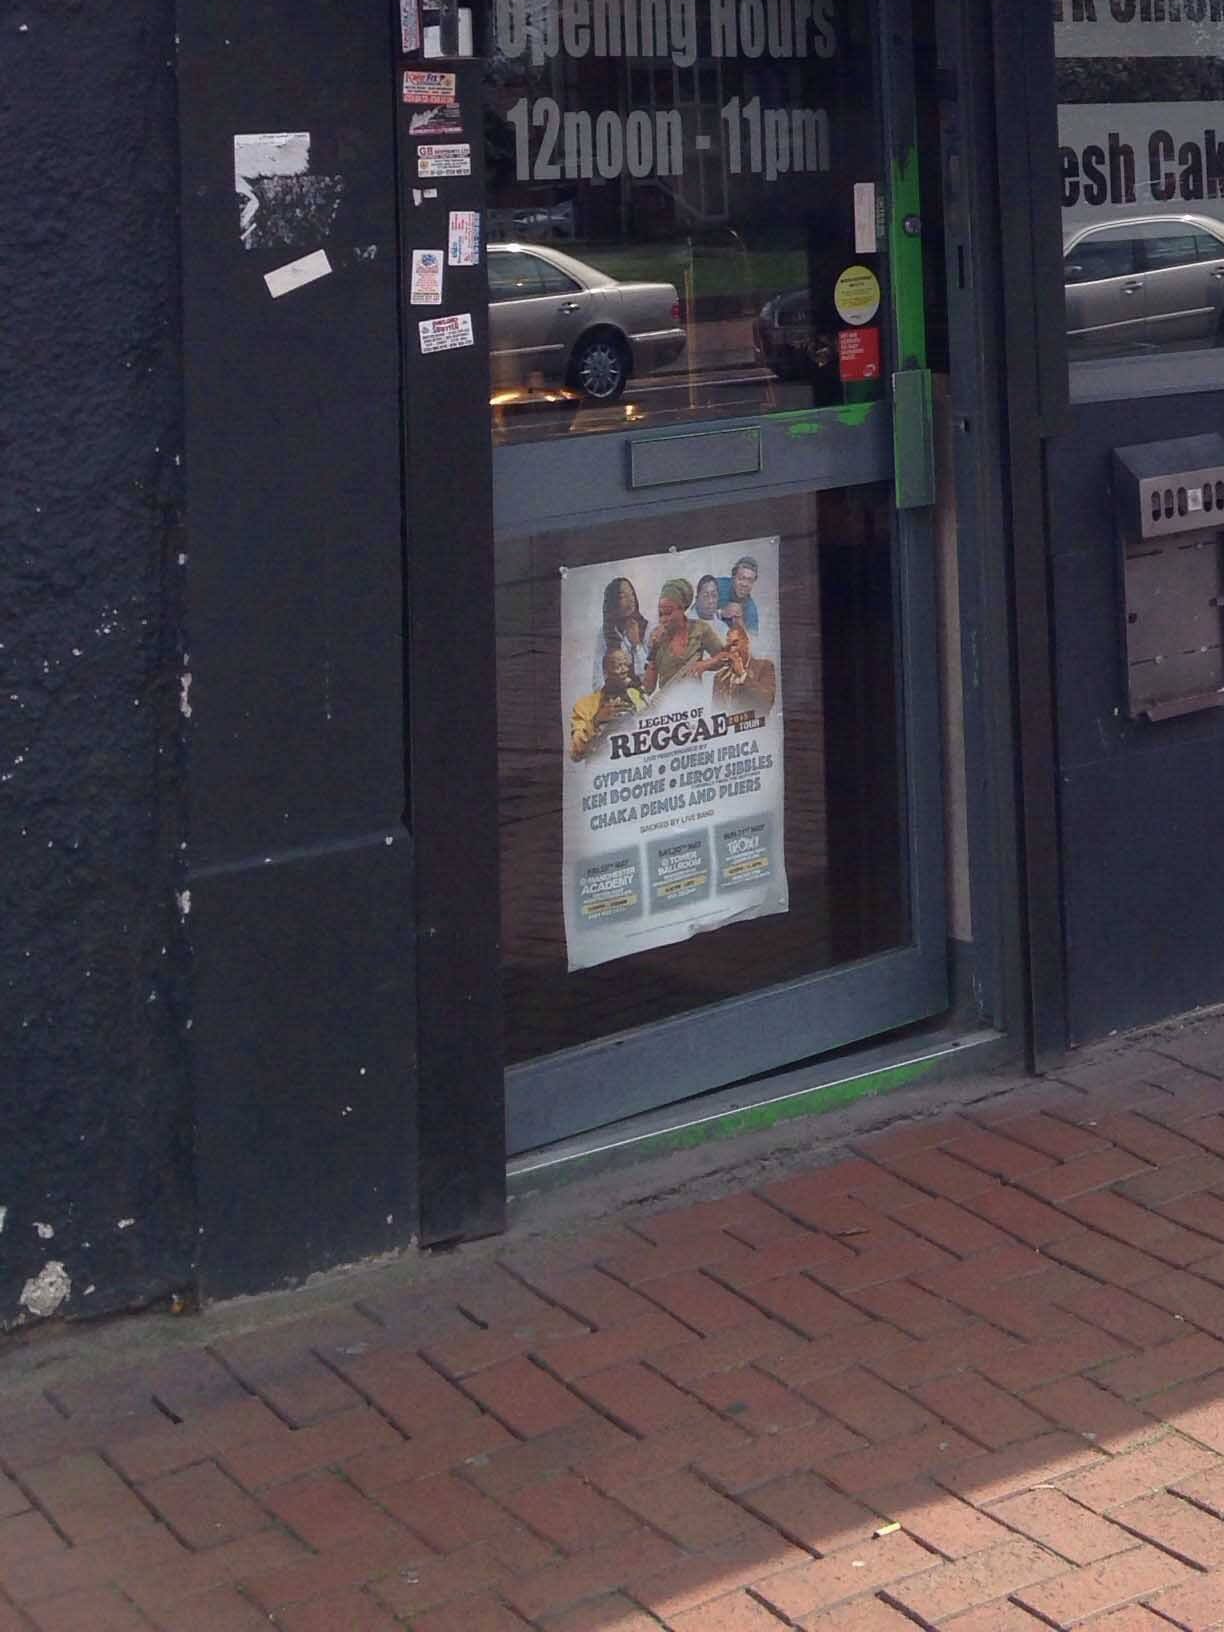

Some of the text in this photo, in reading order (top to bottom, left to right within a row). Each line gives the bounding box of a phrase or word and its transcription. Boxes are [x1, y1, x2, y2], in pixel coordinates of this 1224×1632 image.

[506, 96, 684, 181] 12noon
[720, 95, 831, 181] 11pm
[1057, 131, 1137, 208] esh
[610, 713, 728, 760] REGGAE
[638, 707, 704, 730] LEGENDS OF
[582, 793, 608, 812] KEN
[610, 778, 666, 805] BOOTHE
[680, 767, 722, 787] LEROY
[724, 754, 774, 779] SIBBLES
[593, 764, 653, 790] GYPTIAN
[670, 750, 715, 772] QUEEN
[718, 740, 760, 762] IFRICA
[590, 807, 638, 831] CHAKA
[640, 794, 686, 819] DEMUS
[688, 787, 717, 807] AND
[719, 776, 762, 800] PLIERS
[581, 874, 635, 896] ACADEMY
